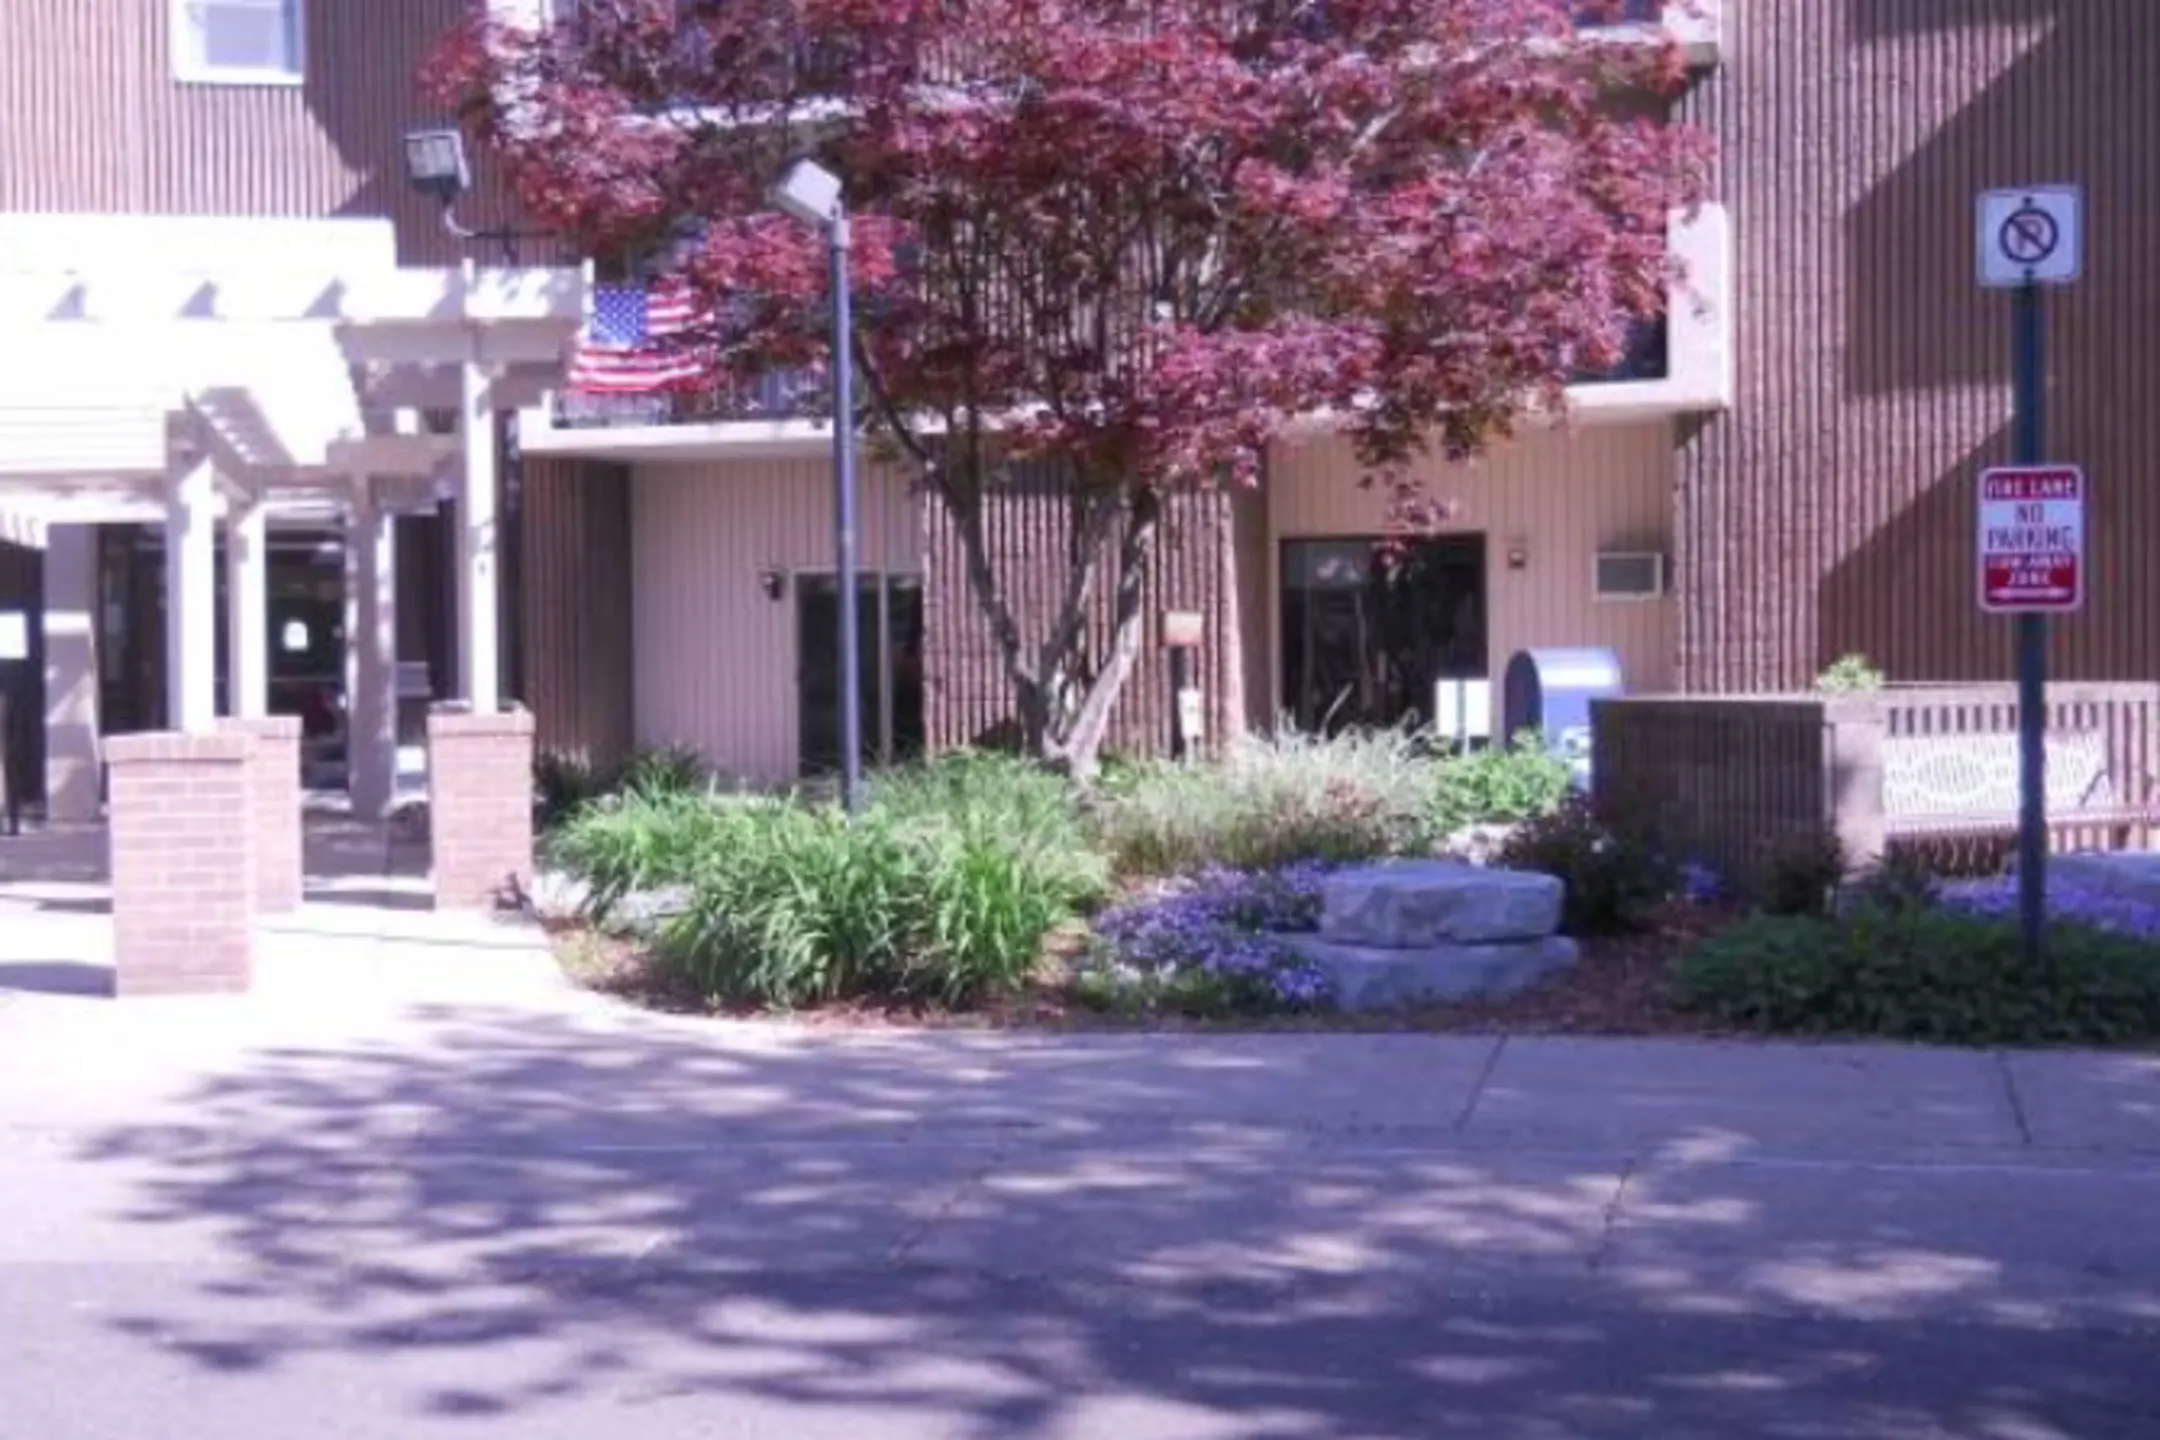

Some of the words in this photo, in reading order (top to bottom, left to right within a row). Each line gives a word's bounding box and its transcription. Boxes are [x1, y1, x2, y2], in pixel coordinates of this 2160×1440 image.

[2030, 477, 2074, 496] LANE
[2015, 502, 2044, 523] NO
[1987, 526, 2075, 550] PARKING
